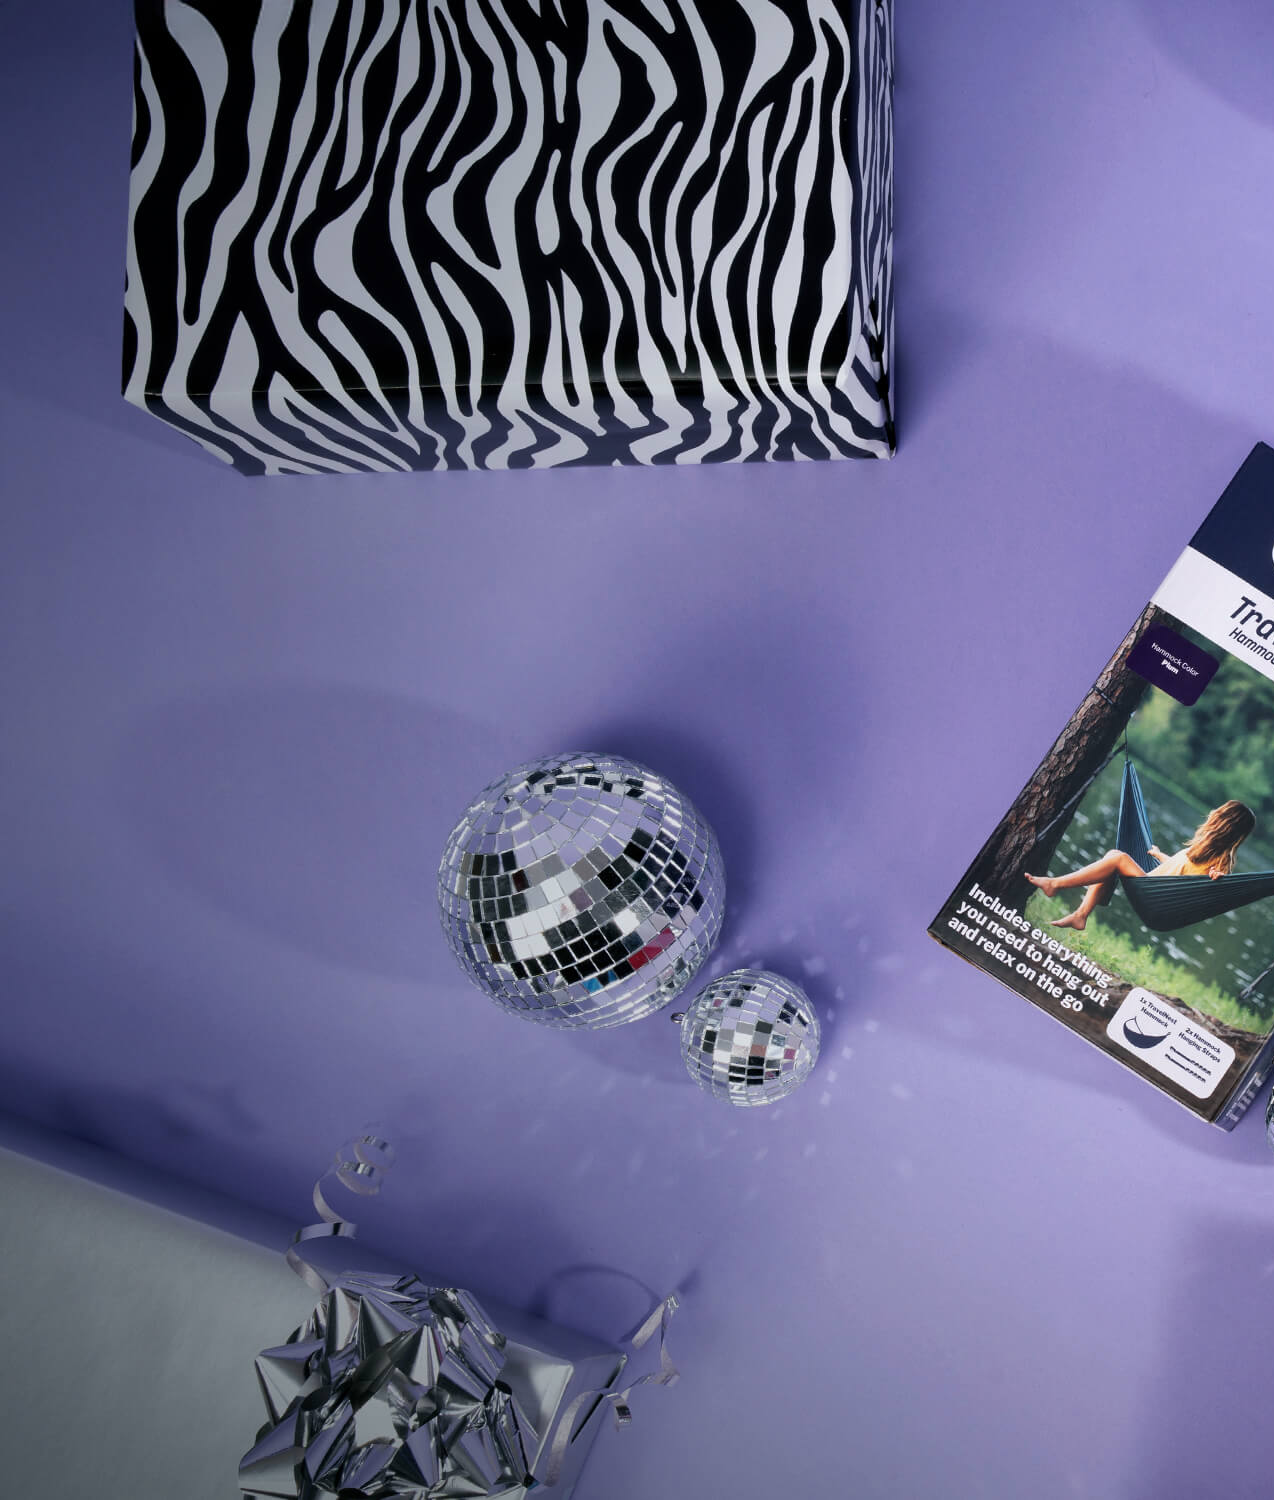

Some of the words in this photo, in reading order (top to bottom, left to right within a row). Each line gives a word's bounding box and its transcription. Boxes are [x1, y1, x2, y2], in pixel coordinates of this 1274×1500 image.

[1152, 643, 1183, 667] Hammock
[1182, 662, 1200, 677] Color
[1161, 659, 1179, 675] Plum
[969, 883, 1031, 932] Includes
[1031, 927, 1113, 989] everything
[948, 917, 980, 941] and
[976, 936, 1016, 967] relax
[1016, 963, 1036, 981] on
[1036, 973, 1063, 998] the
[1060, 994, 1083, 1012] go
[956, 901, 988, 926] you
[986, 921, 1028, 951] need
[1026, 944, 1042, 962] to
[1042, 954, 1082, 990] hang
[1081, 984, 1109, 1007] out
[1141, 1007, 1169, 1029] Hammock
[1148, 1002, 1178, 1026] TravelNest
[1178, 1032, 1203, 1052] Hanging
[1202, 1047, 1221, 1064] Straps
[1193, 1033, 1221, 1054] Hammock
